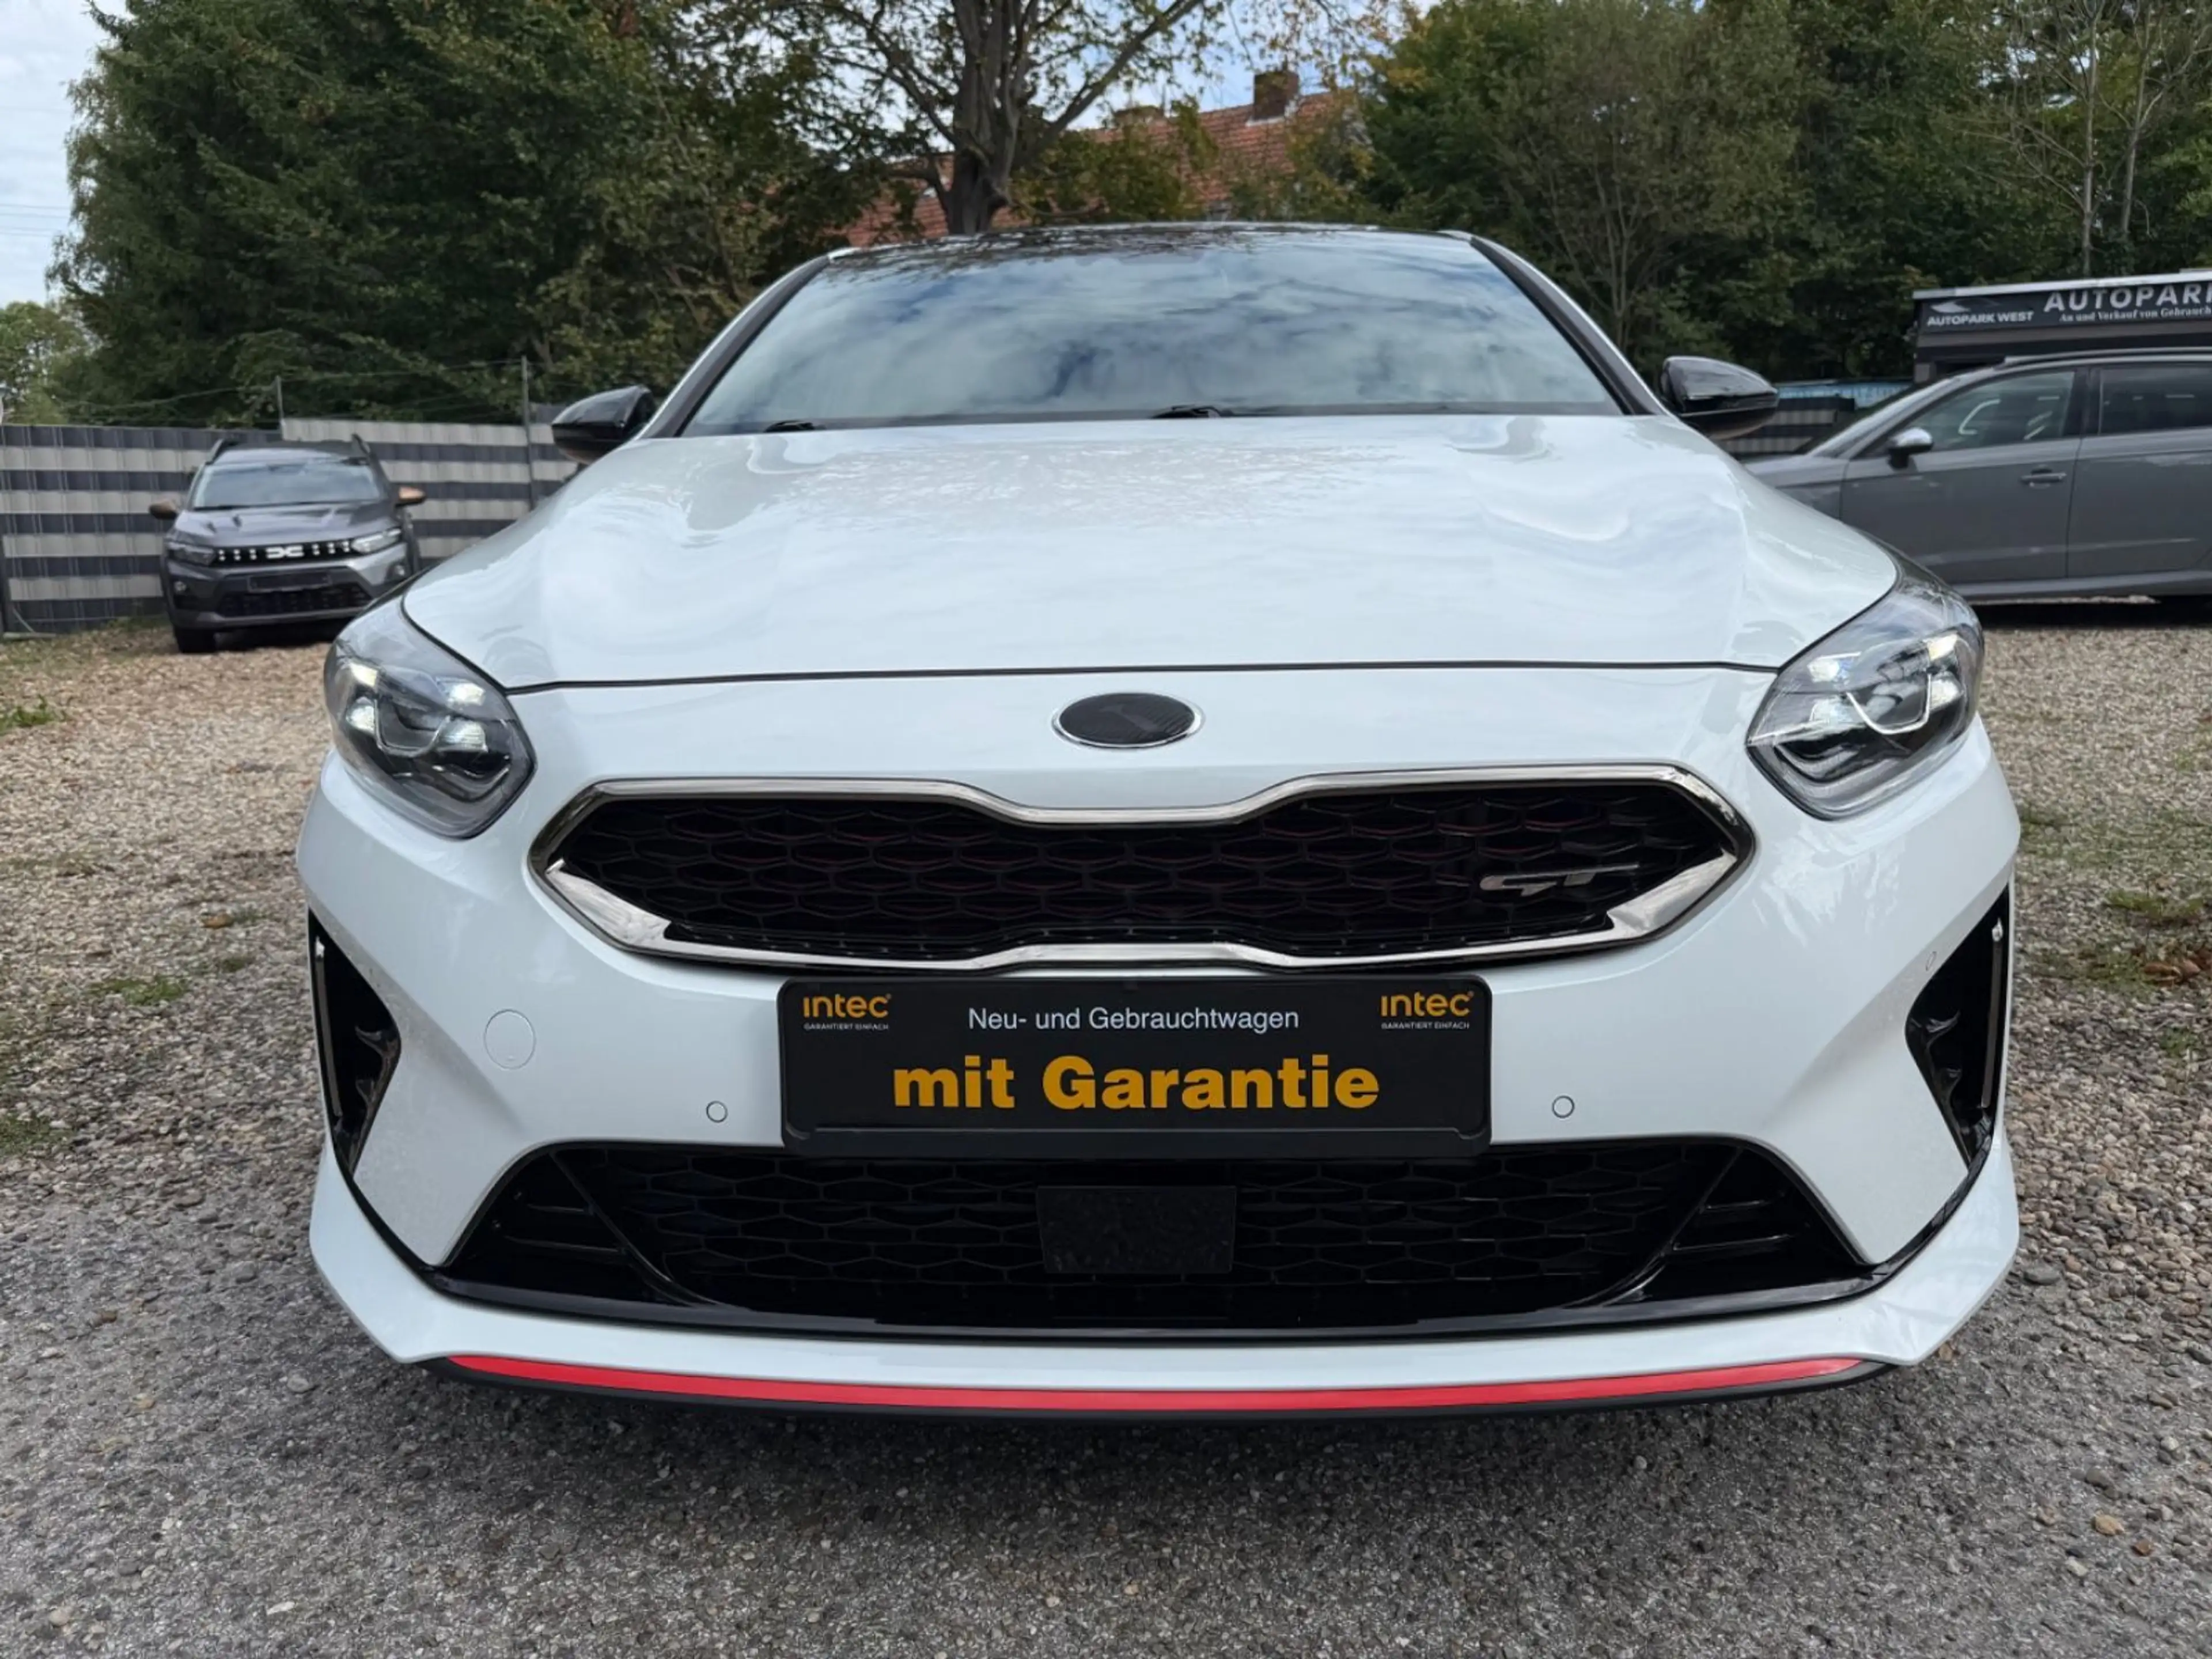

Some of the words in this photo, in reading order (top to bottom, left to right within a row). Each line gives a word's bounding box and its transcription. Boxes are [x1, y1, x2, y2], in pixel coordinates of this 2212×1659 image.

[1927, 313, 1995, 327] AUTOPARK
[1997, 310, 2034, 323] WEST
[2075, 312, 2096, 321] und
[2097, 309, 2138, 321] Verkauf
[803, 994, 889, 1018] intec
[1381, 991, 1471, 1017] intec
[804, 1022, 853, 1031] GARANTIERT
[969, 1008, 1027, 1029] Neu-
[1036, 1007, 1081, 1029] und
[1089, 1006, 1300, 1035] Gebrauchtwagen
[1381, 1021, 1433, 1029] GARANTIERT
[1434, 1021, 1469, 1029] EINFACH
[893, 1055, 1016, 1109] mit
[1042, 1054, 1380, 1110] Garantie
